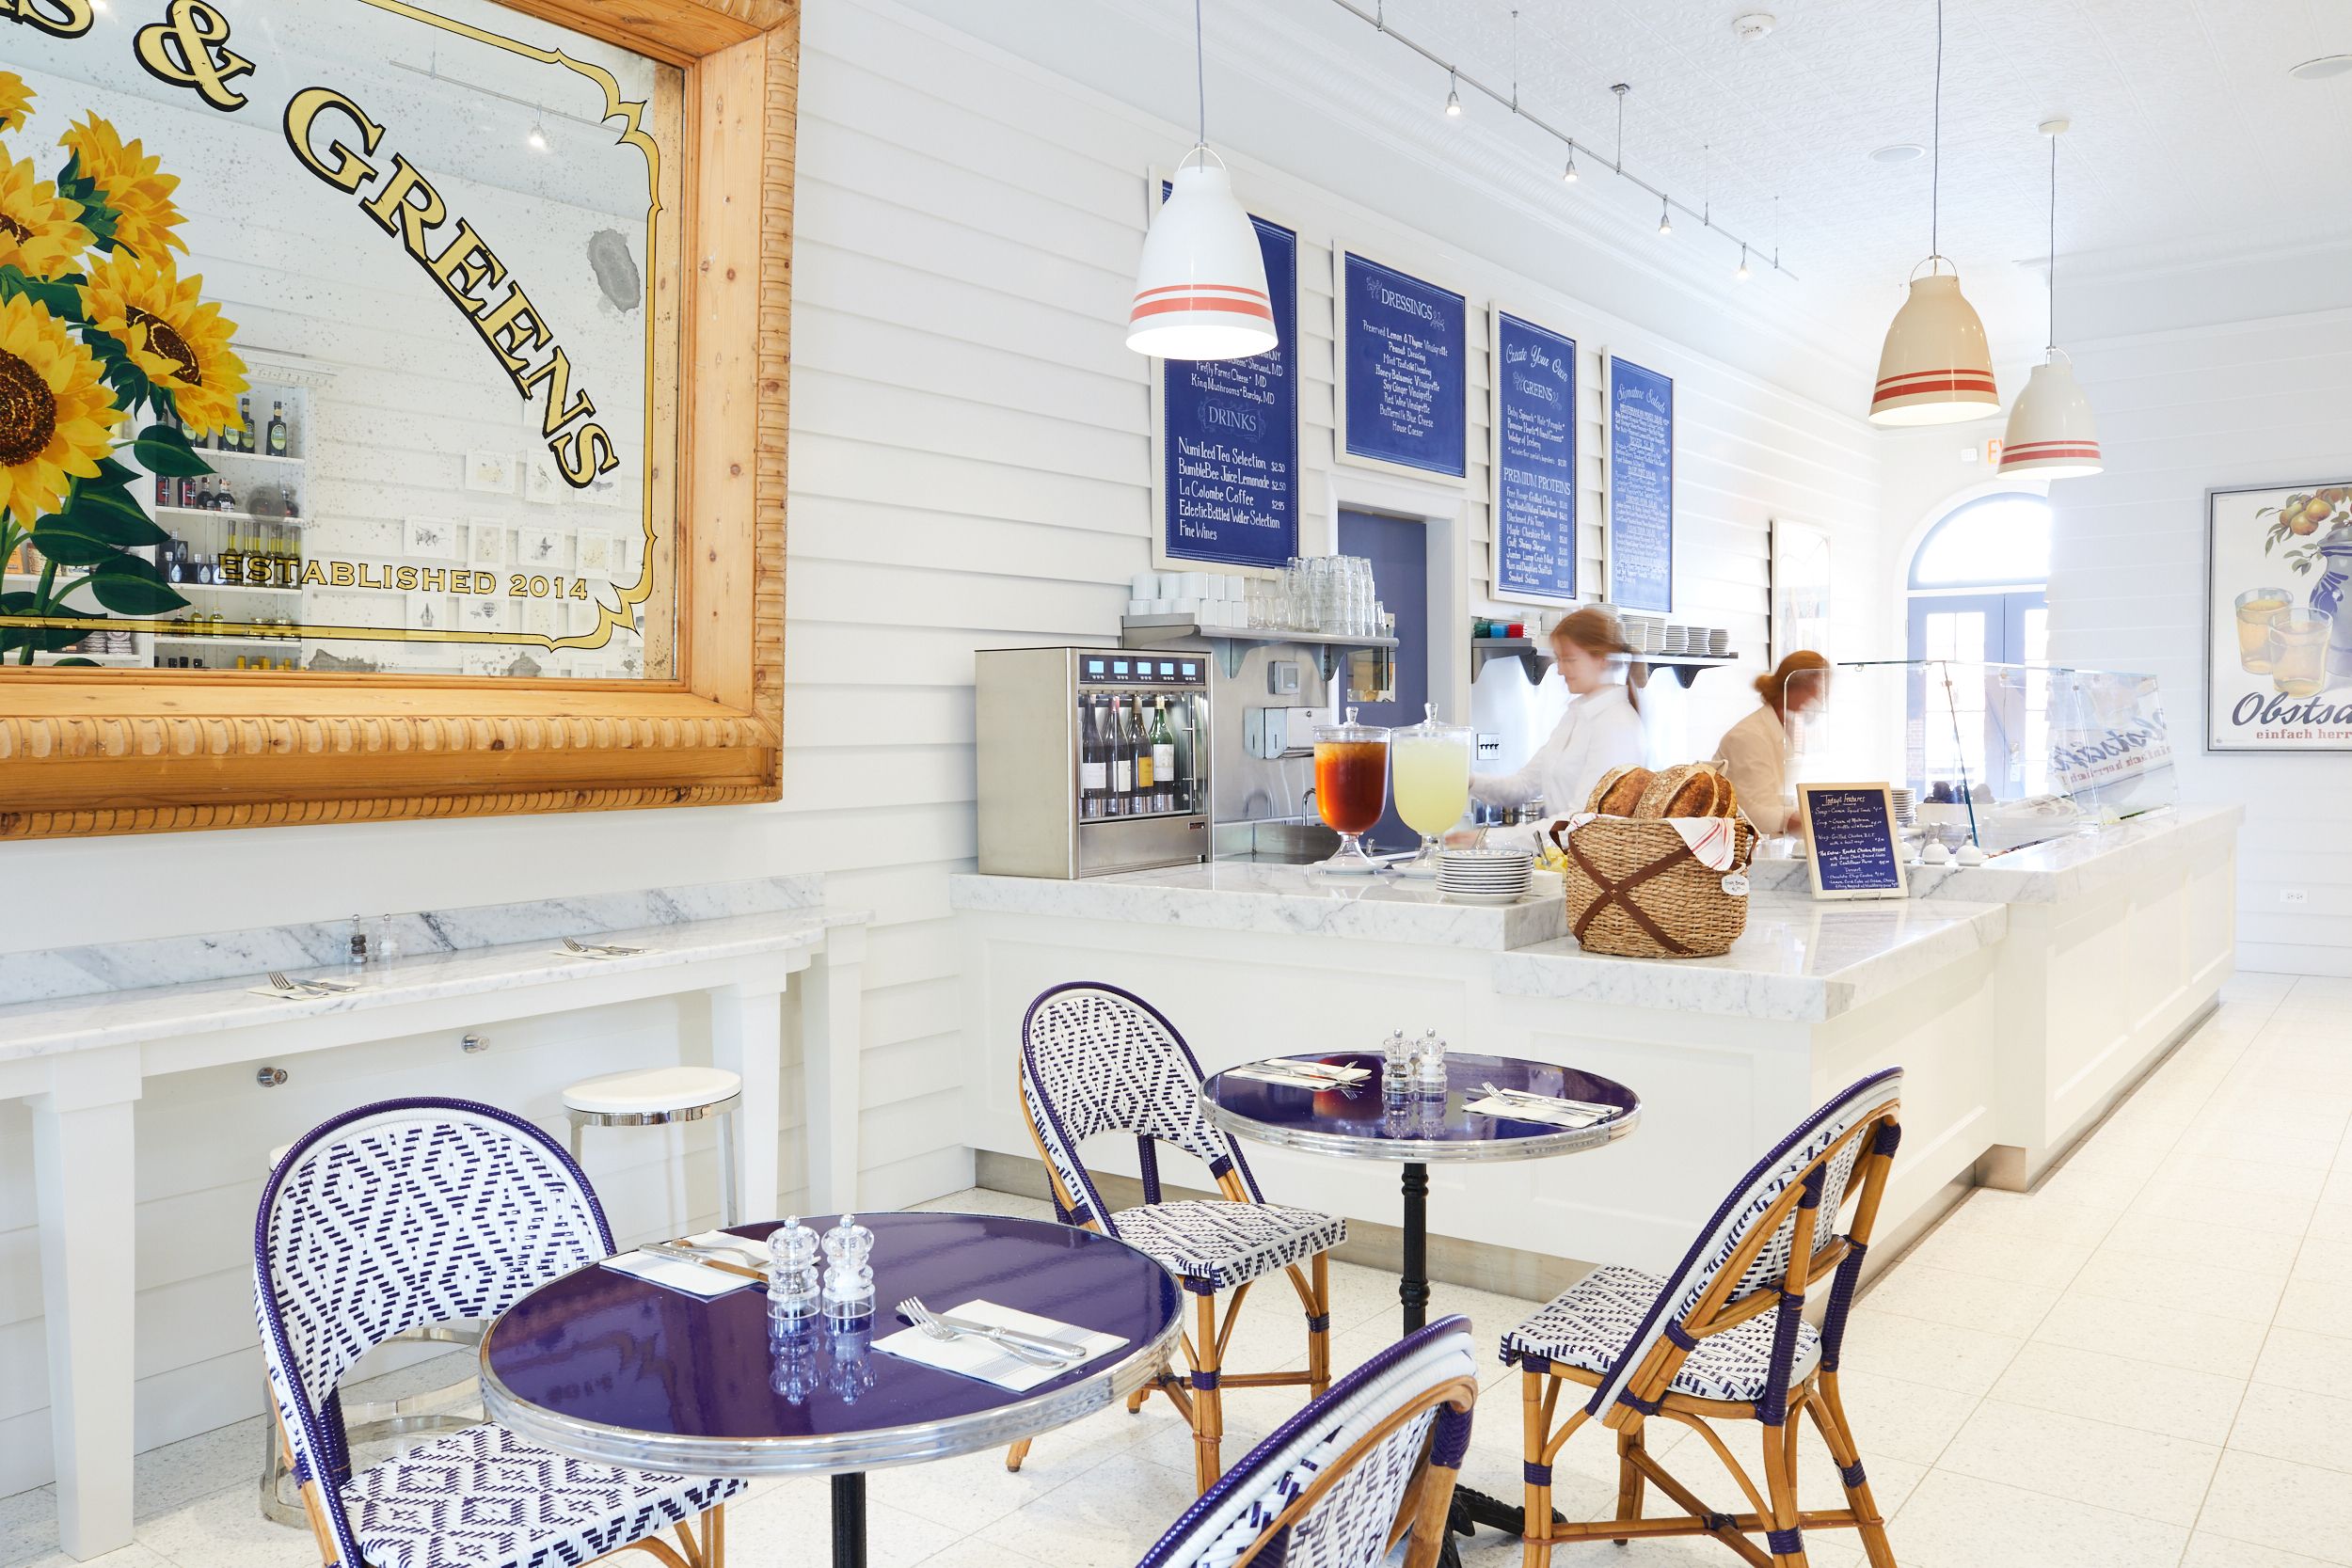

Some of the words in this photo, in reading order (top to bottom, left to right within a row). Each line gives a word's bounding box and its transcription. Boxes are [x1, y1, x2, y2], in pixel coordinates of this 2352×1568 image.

[134, 0, 255, 112] &
[283, 87, 620, 489] GREENS
[1382, 289, 1433, 321] DRESSINGS
[1387, 327, 1403, 341] Lemon
[1408, 335, 1423, 349] Thyme
[1423, 341, 1449, 357] Vinaigrette
[1272, 364, 1283, 377] MD
[1407, 348, 1426, 366] Dressing
[1506, 344, 1528, 364] Create
[1531, 345, 1549, 369] Your
[1552, 359, 1569, 383] Own
[1197, 360, 1214, 377] Firefly
[1215, 364, 1231, 379] Farms
[1232, 369, 1248, 384] Cheese
[1256, 374, 1267, 388] MD
[1376, 365, 1391, 381] Honey
[1392, 370, 1413, 385] Balsamic
[1415, 375, 1440, 393] Vinaigrette
[1415, 364, 1433, 381] Dressing
[1192, 373, 1207, 392] King
[1208, 377, 1240, 397] Mushrooms
[1263, 391, 1275, 405] MD
[1393, 383, 1408, 397] Ginger
[1408, 387, 1433, 403] Vinaigrette
[1523, 380, 1553, 402] GREENS
[1617, 384, 1645, 404] Signature
[1646, 389, 1665, 415] Salads
[1380, 404, 1406, 420] Buttermilk
[1406, 411, 1417, 423] Blue
[1418, 415, 1435, 428] Cheese
[1385, 392, 1394, 405] Red
[1406, 399, 1431, 415] Vinaigrette
[1209, 406, 1257, 432] DRINKS
[1393, 420, 1407, 434] House
[1408, 425, 1424, 437] Caesar
[1179, 436, 1200, 457] Numi
[1201, 441, 1216, 460] Iced
[1216, 445, 1231, 463] Tea
[1232, 449, 1267, 470] Selection
[1271, 462, 1286, 473] $2.50
[1179, 458, 1219, 481] BumbleBee
[1221, 466, 1237, 483] Juice
[1238, 469, 1270, 489] Lemonade
[1272, 482, 1287, 492] $2.50
[1504, 467, 1537, 488] PREMIUM
[1539, 475, 1571, 496] PROTEINS
[1180, 479, 1190, 497] La
[1192, 481, 1224, 501] Colombe
[1226, 486, 1254, 507] Coffee
[1272, 500, 1285, 511] $2.95
[1180, 499, 1208, 518] Eclectic
[1208, 503, 1231, 523] Bottled
[1231, 507, 1249, 525] Water
[1249, 511, 1280, 530] Selection
[1180, 519, 1196, 538] Fine
[1196, 522, 1217, 541] Wines
[217, 553, 497, 594] ESTABLISHED
[509, 574, 589, 600] 2014
[2256, 728, 2312, 739] einfach
[1844, 794, 1867, 803] Features
